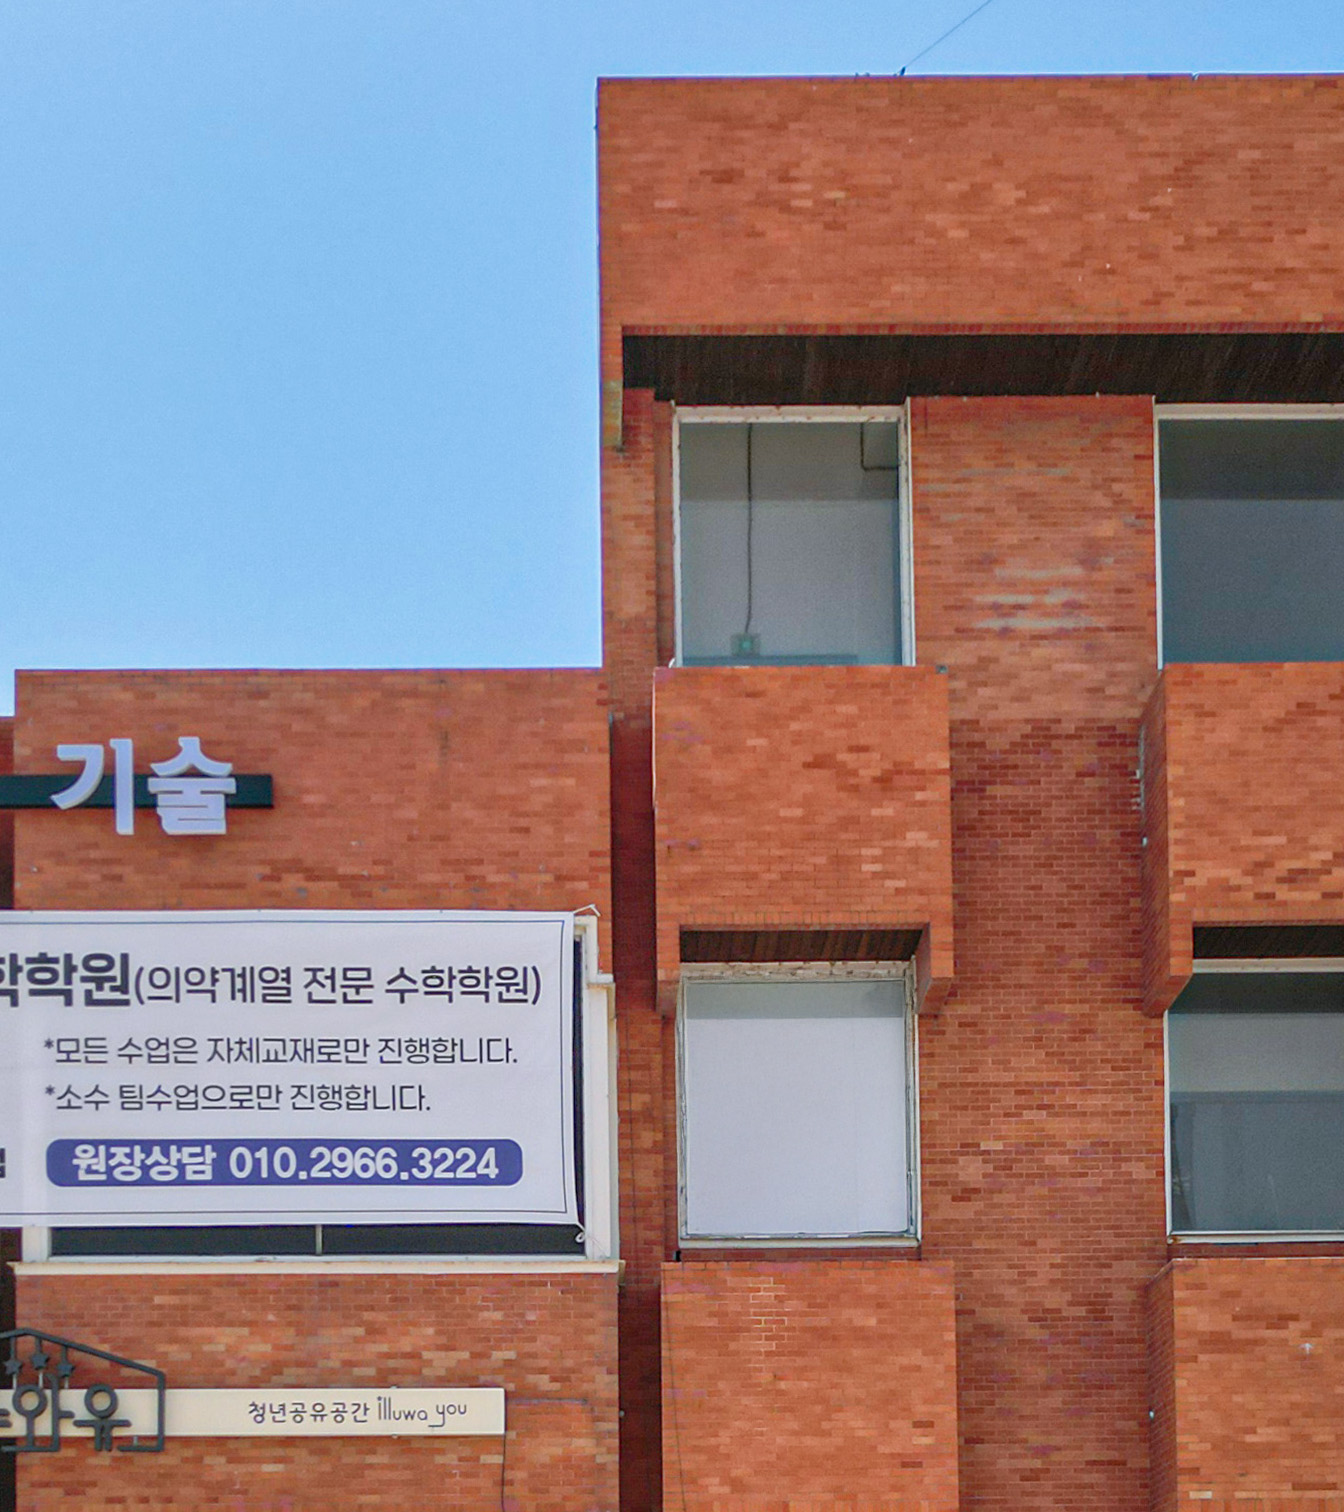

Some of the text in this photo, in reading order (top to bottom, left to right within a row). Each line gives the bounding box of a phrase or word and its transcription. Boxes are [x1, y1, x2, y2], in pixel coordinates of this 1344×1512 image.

[50, 736, 236, 836] 기술
[303, 965, 375, 1005] 전문
[385, 964, 542, 1006] 수학학원)
[117, 1037, 198, 1066] 수업은
[206, 1037, 370, 1066] 자체교재로만
[377, 1036, 519, 1066] 진행합니다.
[119, 1083, 282, 1113] 팀수업으로만
[290, 1083, 432, 1113] 진행합니다.
[72, 1142, 500, 1184] 원장상담 010.2966.3224
[248, 1400, 370, 1425] 청년공유공간
